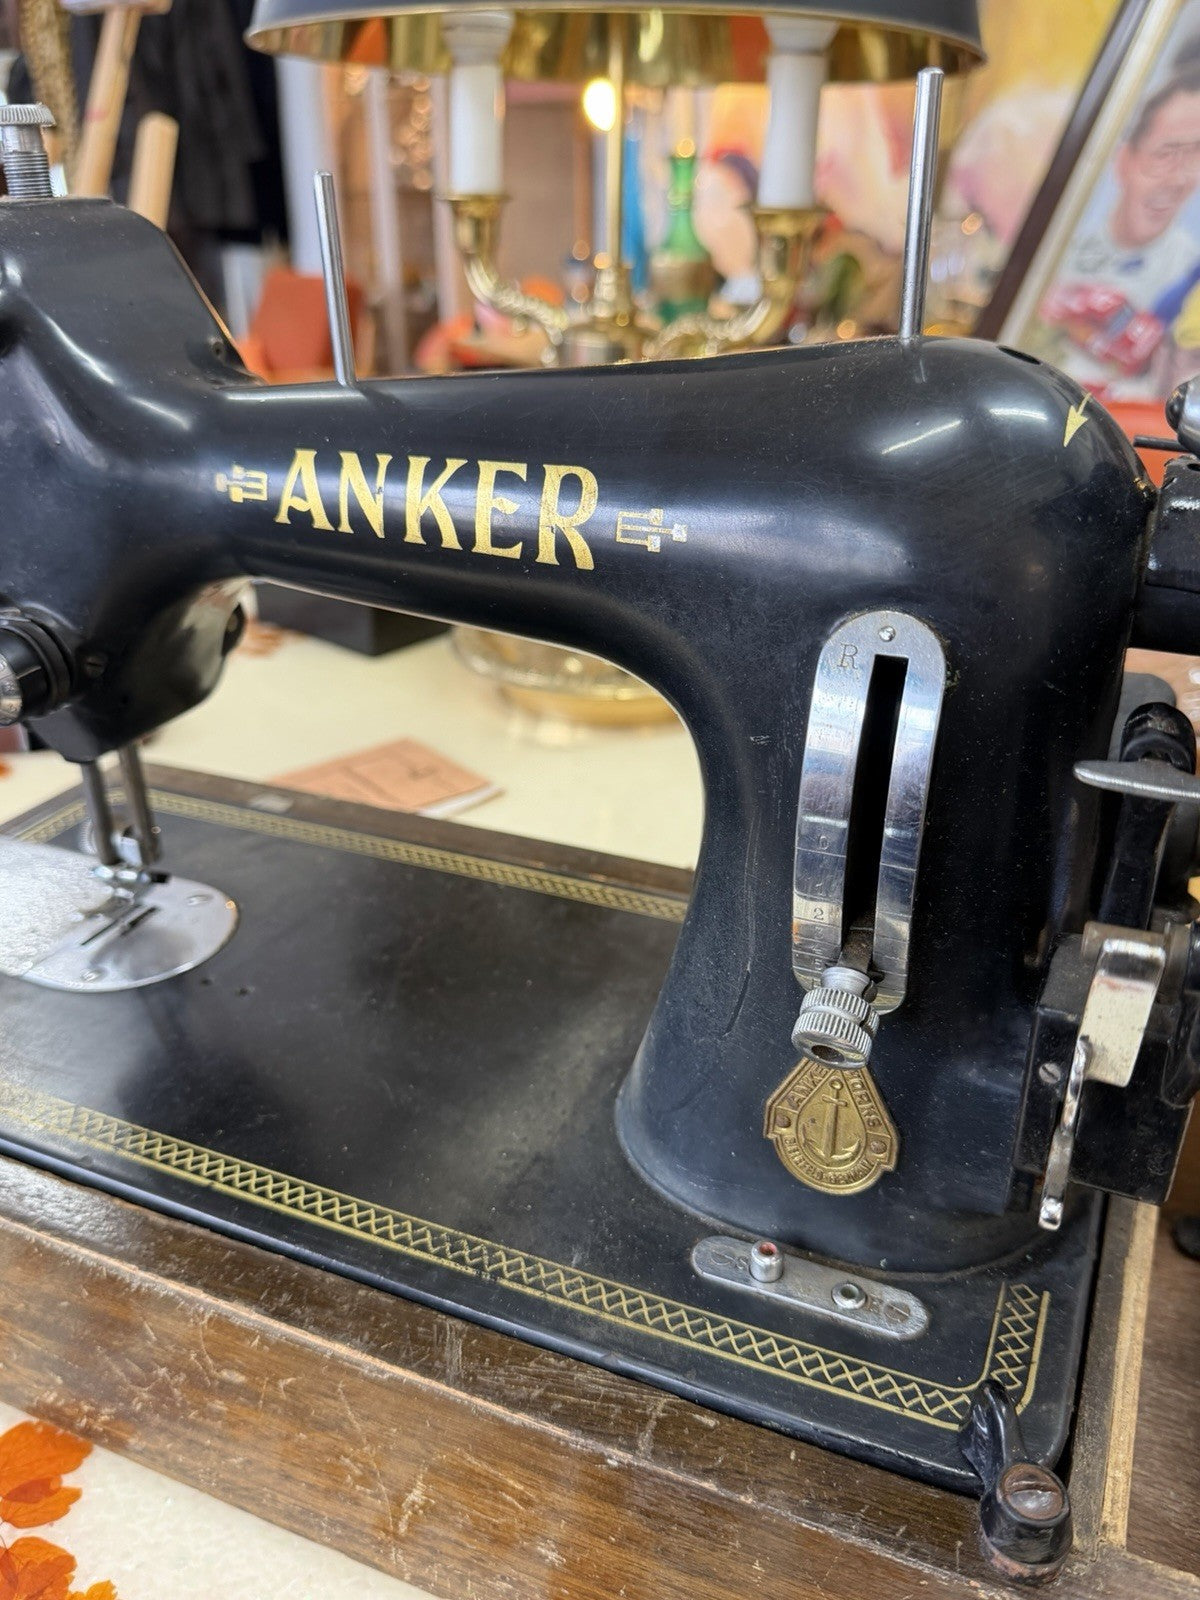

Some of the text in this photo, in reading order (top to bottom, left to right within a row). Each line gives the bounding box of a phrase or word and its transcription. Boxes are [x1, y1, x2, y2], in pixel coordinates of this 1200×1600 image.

[274, 448, 599, 571] ANKER
[836, 643, 859, 670] R
[813, 907, 825, 921] 2
